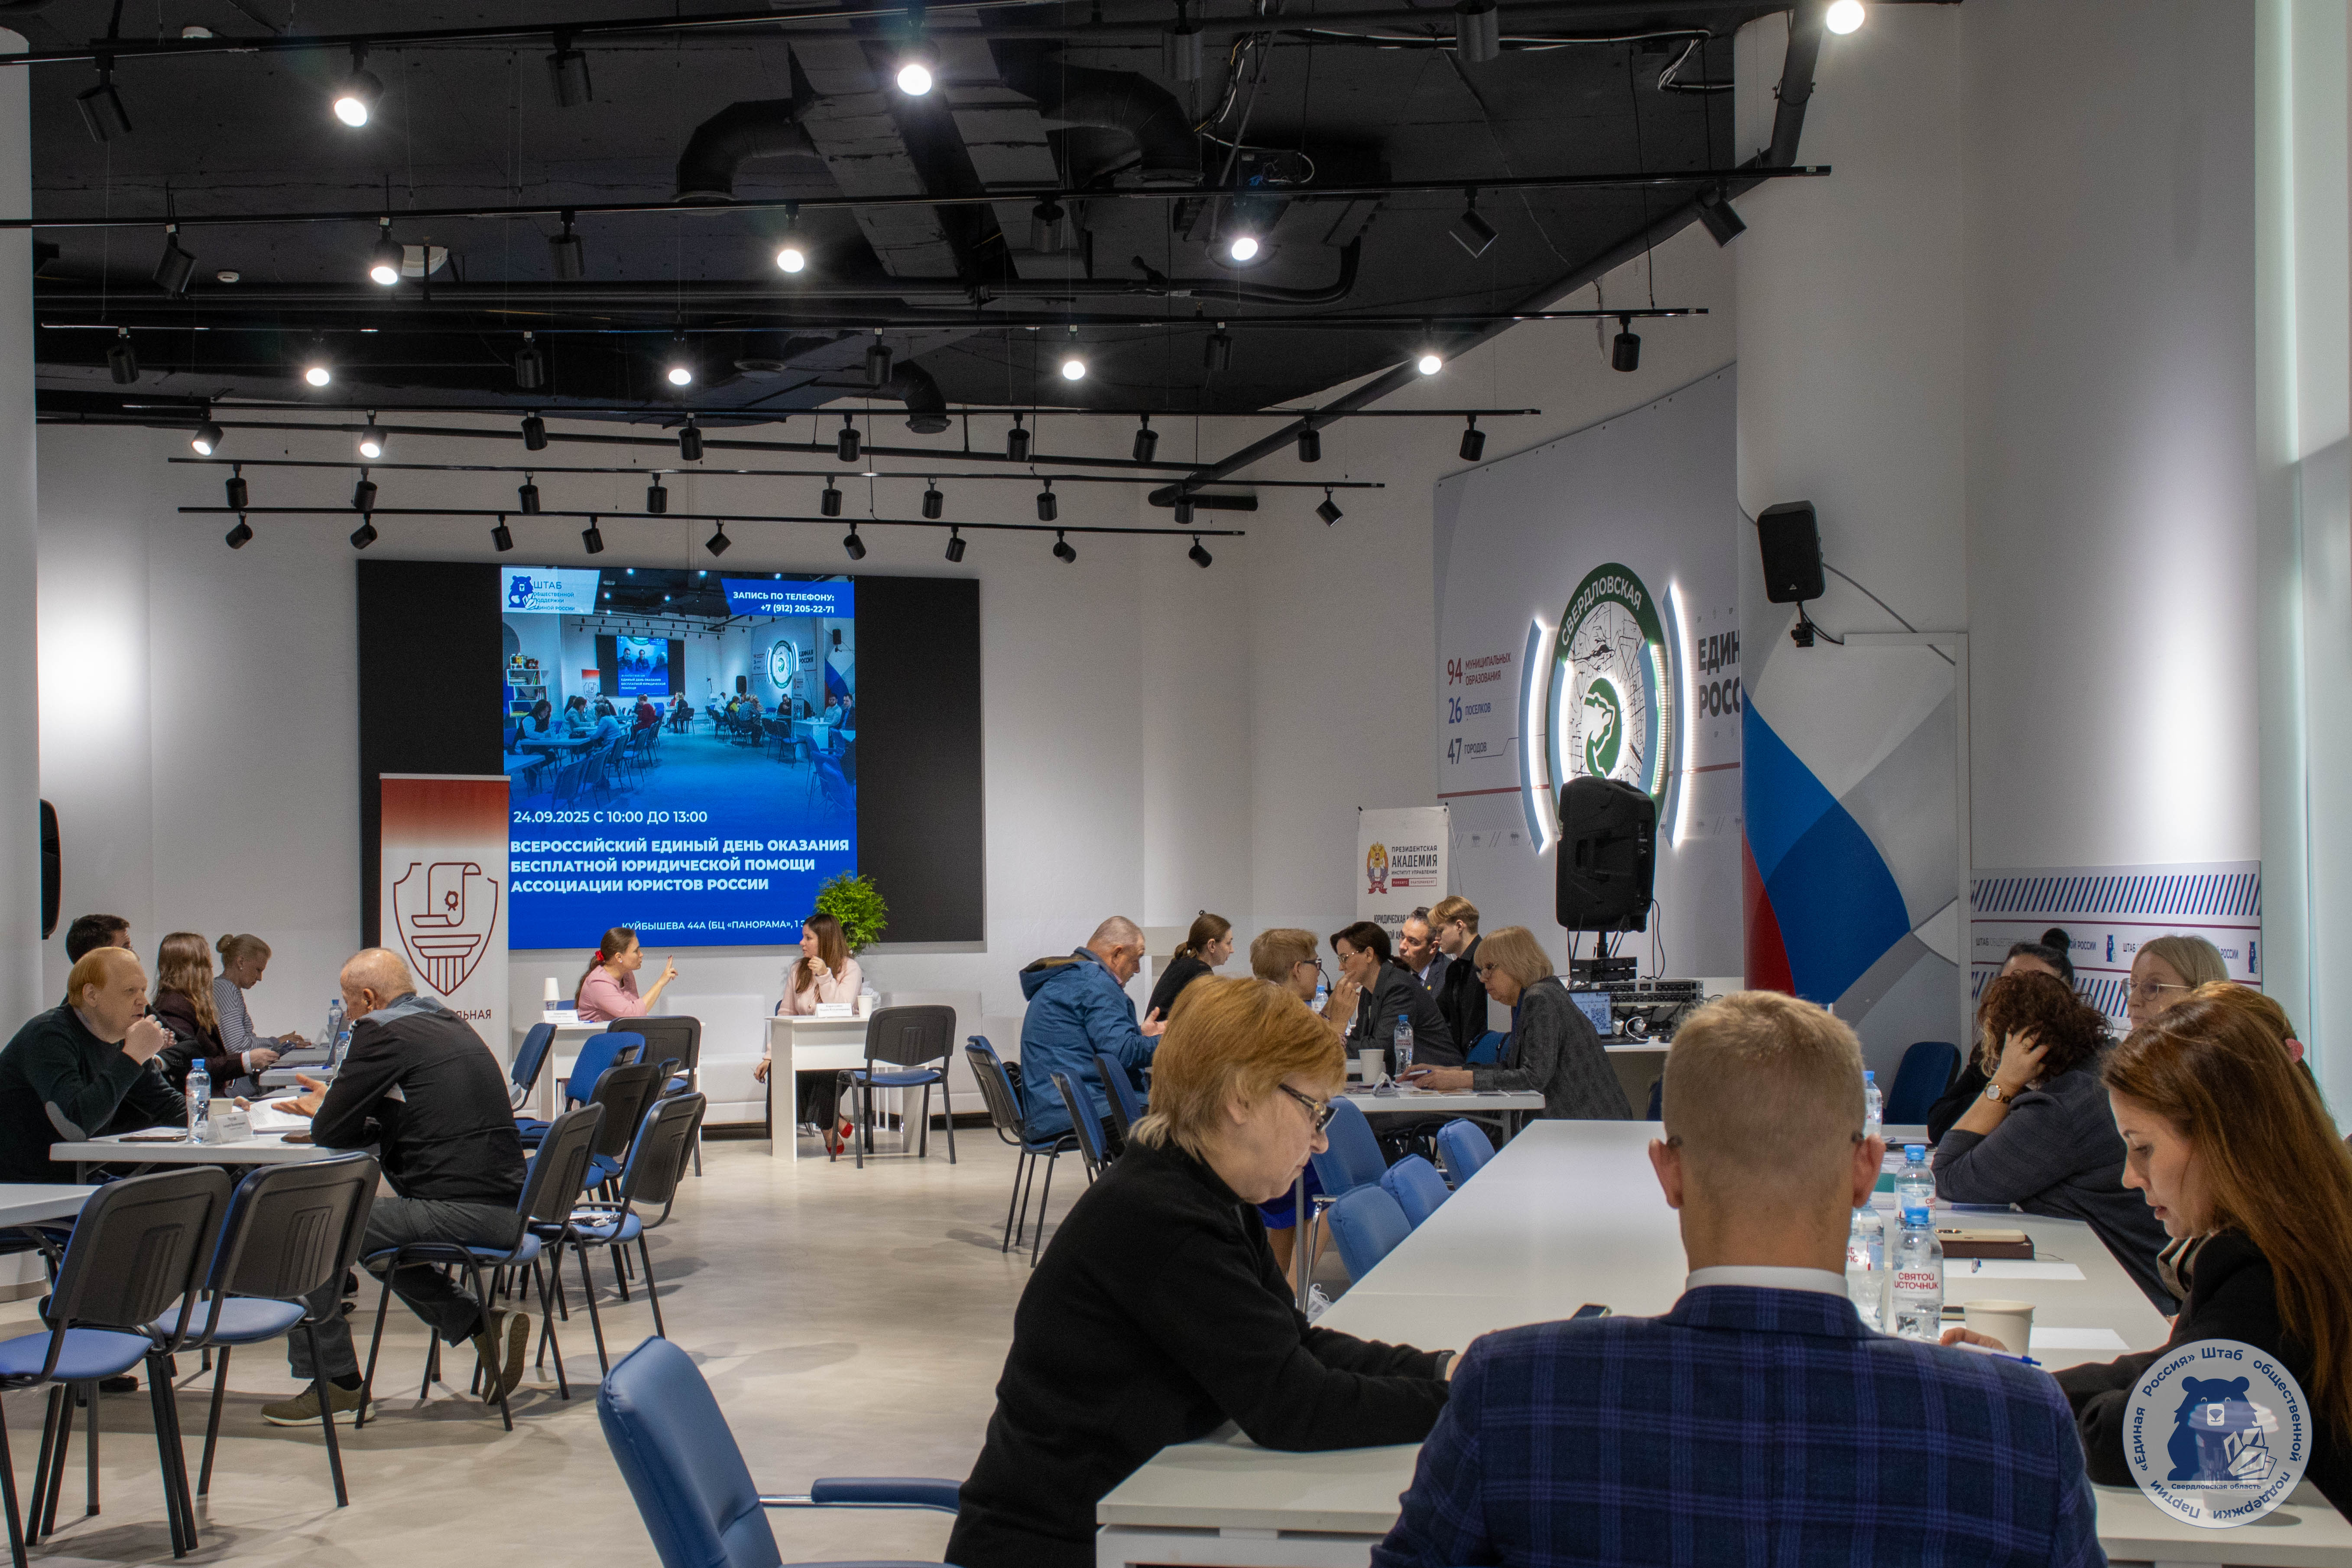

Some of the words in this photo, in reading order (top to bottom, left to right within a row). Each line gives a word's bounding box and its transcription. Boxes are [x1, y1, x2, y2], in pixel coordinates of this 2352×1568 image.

[534, 581, 562, 589] ШТАБ
[785, 593, 834, 601] ТЕЛЕФОНУ:
[773, 604, 793, 614] (912)
[795, 605, 834, 614] 205-22-71
[1562, 576, 1642, 646] СВЕРДЛОВСКАЯ
[1698, 630, 1740, 676] ЕДИН
[1447, 657, 1463, 686] 94
[1466, 652, 1511, 670] МУНИЦИПАЛЬНЫХ
[1465, 670, 1501, 686] ОБРАЗОВАНИЯ
[1698, 676, 1740, 719] РОСС
[1448, 696, 1463, 724] 26
[1465, 702, 1491, 715] ПОСЕЛКОВ
[1447, 737, 1462, 764] 47
[1464, 742, 1487, 754] ГОРОДОВ
[513, 811, 590, 823] 24.09.2025
[594, 811, 603, 823] С
[607, 811, 643, 823] 10:00
[647, 811, 669, 825] ДО
[673, 811, 708, 822] 13:00
[510, 838, 647, 853] ВСЕРОССИЙСКИЙ
[652, 837, 719, 854] ЕДИНЫЙ
[723, 840, 764, 853] ДЕНЬ
[767, 839, 849, 851] ОКАЗАНИЯ
[510, 857, 617, 873] БЕСПЛАТНОЙ
[622, 856, 740, 873] ЮРИДИЧЕСКОЙ
[745, 859, 815, 872] ПОМОЩИ
[1392, 854, 1437, 868] АКАДЕМИЯ
[510, 880, 623, 893] АССОЦИАЦИИ
[627, 879, 703, 891] ЮРИСТОВ
[707, 878, 769, 890] РОССИИ
[622, 921, 685, 930] КУЙБЫШЕВА
[708, 920, 725, 930] (БЦ
[727, 920, 793, 929] «ПАНОРАМА»,
[1374, 914, 1406, 925] ЮРИДИЧЕСКАЯ
[2077, 941, 2096, 950] РОССИИ
[2123, 943, 2136, 953] ШТАБ
[2220, 948, 2239, 959] РОССИИ
[456, 1009, 491, 1020] ЛЬНАЯ
[1898, 1272, 1934, 1281] СВЯТОЙ
[1894, 1280, 1939, 1290] ИСТОЧНИК
